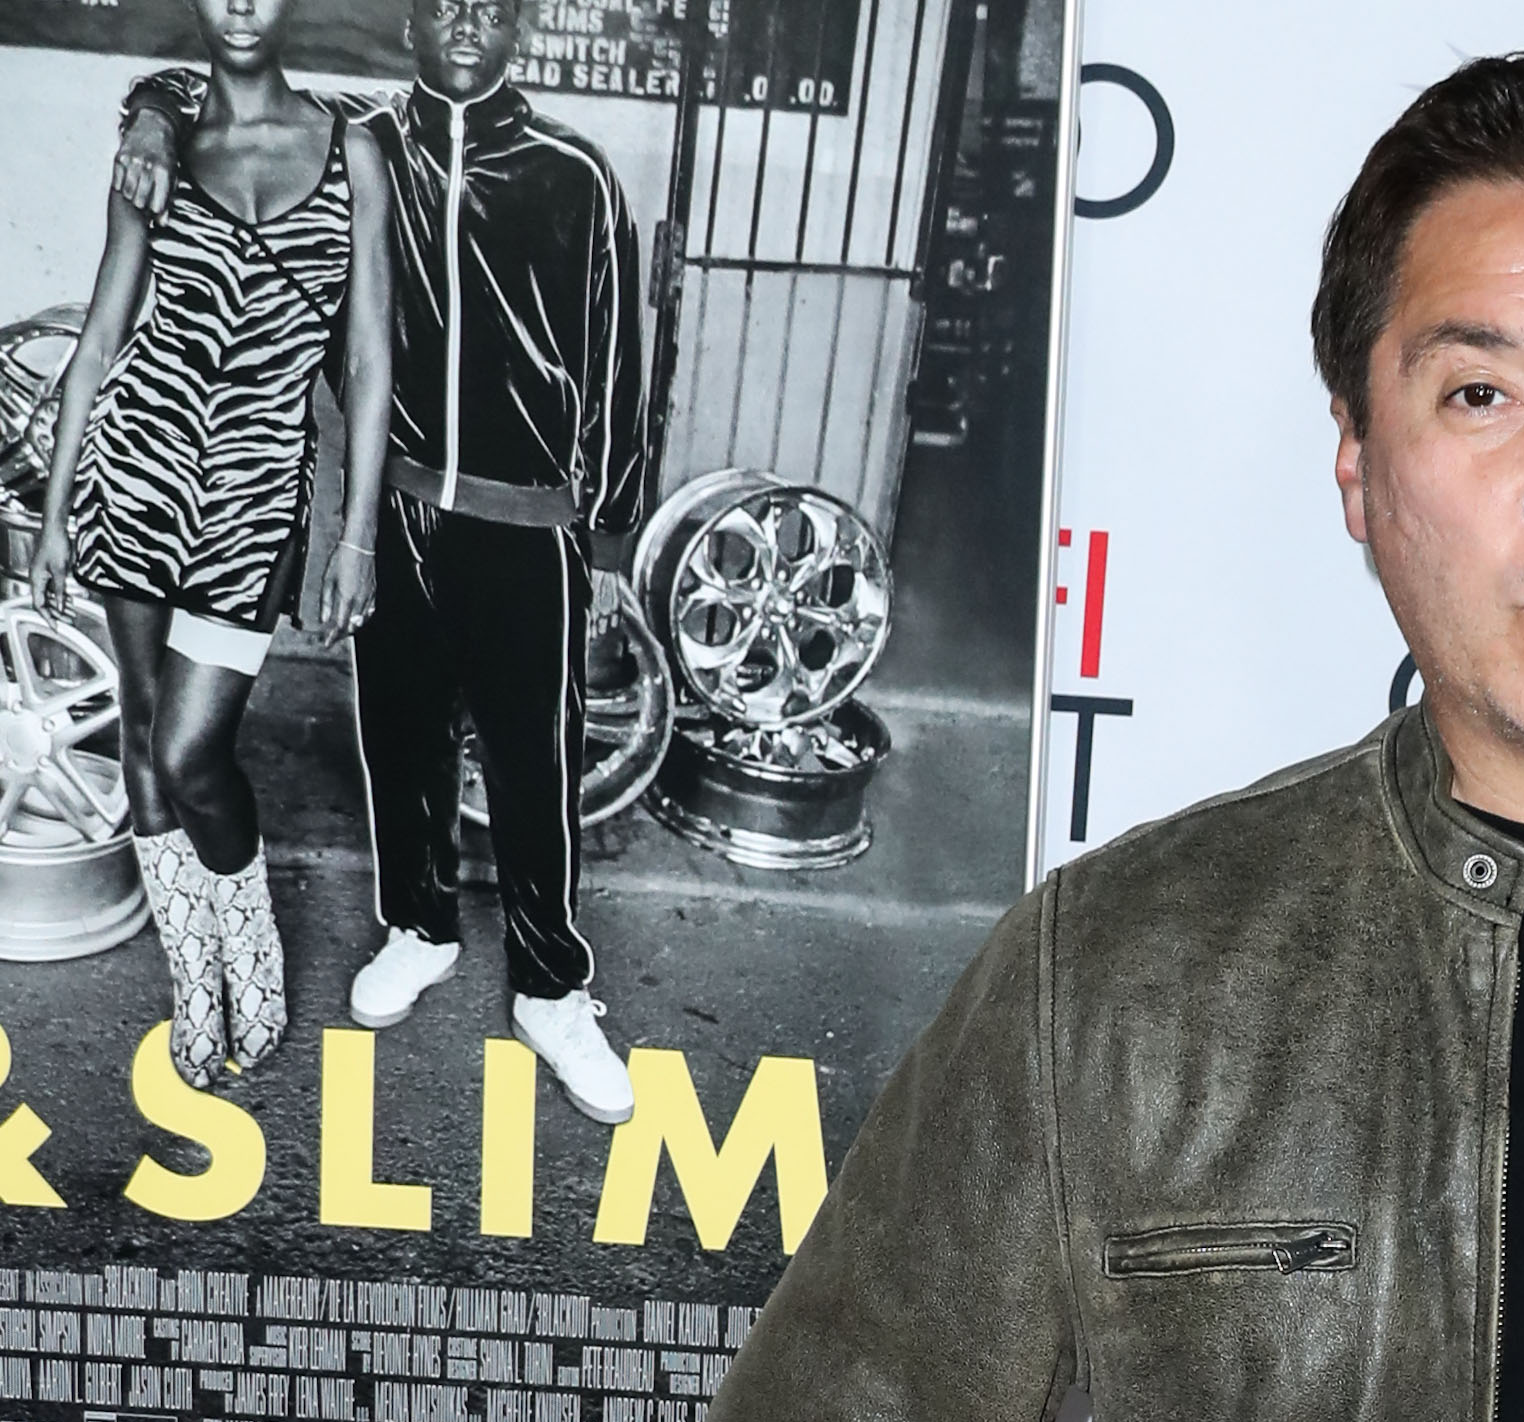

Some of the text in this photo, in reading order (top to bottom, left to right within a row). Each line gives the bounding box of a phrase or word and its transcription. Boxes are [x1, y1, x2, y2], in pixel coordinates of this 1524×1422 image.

[529, 33, 627, 65] SWITCH
[510, 57, 561, 87] EAD
[572, 63, 680, 97] SEALER
[124, 1019, 829, 1256] SLIM
[207, 1272, 249, 1316] CREATIVE
[644, 1301, 675, 1345] DANIEL
[182, 1320, 218, 1363] CARMEN
[85, 1362, 122, 1405] GILBERT
[129, 1365, 161, 1408] JASON
[164, 1368, 192, 1410] CLOTH
[235, 1372, 266, 1415] JAMES
[268, 1374, 289, 1416] FREY
